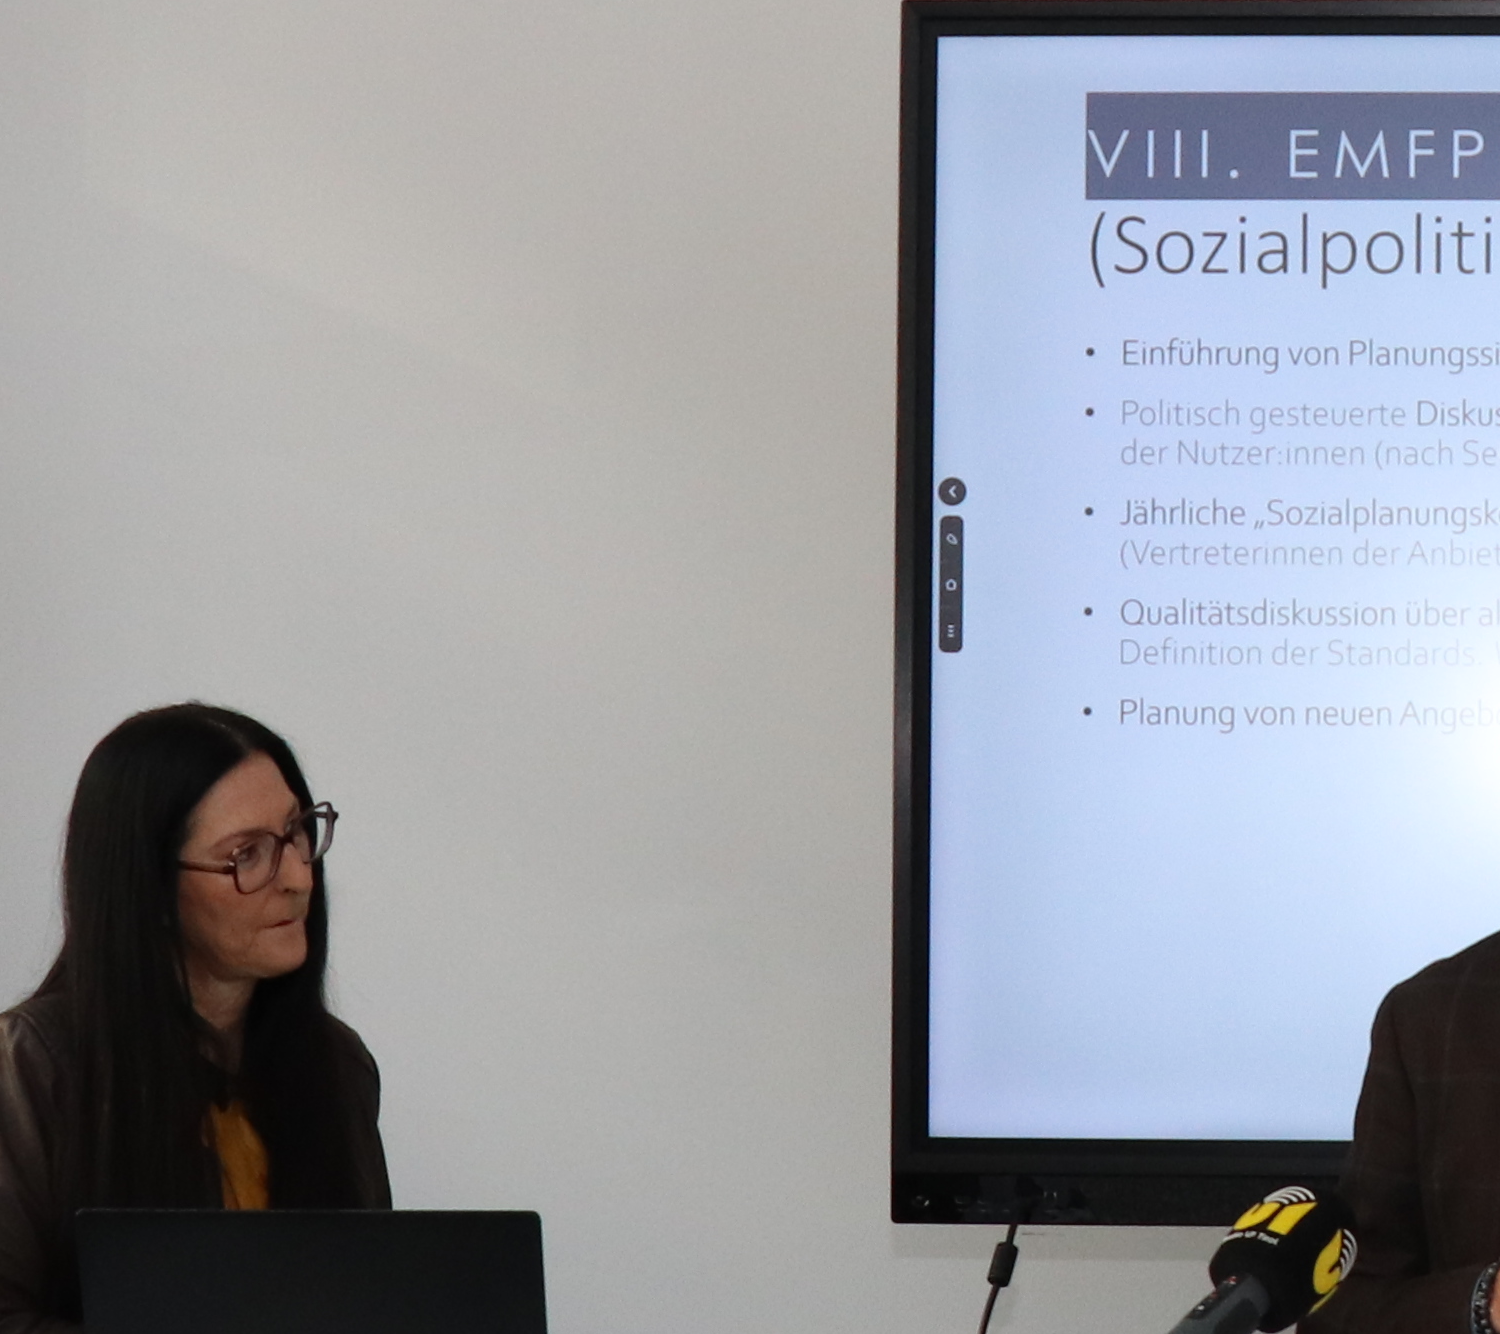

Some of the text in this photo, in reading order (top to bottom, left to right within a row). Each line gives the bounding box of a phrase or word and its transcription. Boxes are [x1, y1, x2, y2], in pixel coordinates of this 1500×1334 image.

[1087, 128, 1240, 180] VIII.
[1121, 336, 1280, 376] Einführung
[1287, 345, 1340, 368] von
[1120, 397, 1241, 428] Politisch
[1248, 402, 1407, 436] gesteuerte
[1119, 437, 1170, 467] der
[1176, 438, 1366, 468] Nutzer:innen
[1374, 438, 1455, 472] (nach
[1118, 496, 1247, 527] Jährliche
[1119, 538, 1344, 572] (Vertreterinnen
[1352, 538, 1402, 568] der
[1119, 596, 1397, 628] Qualitätsdiskussion
[1405, 597, 1472, 628] über
[1119, 636, 1263, 667] Definition
[1270, 637, 1320, 667] der
[1119, 696, 1236, 736] Planung
[1242, 705, 1296, 727] von
[1304, 705, 1393, 728] neuen
